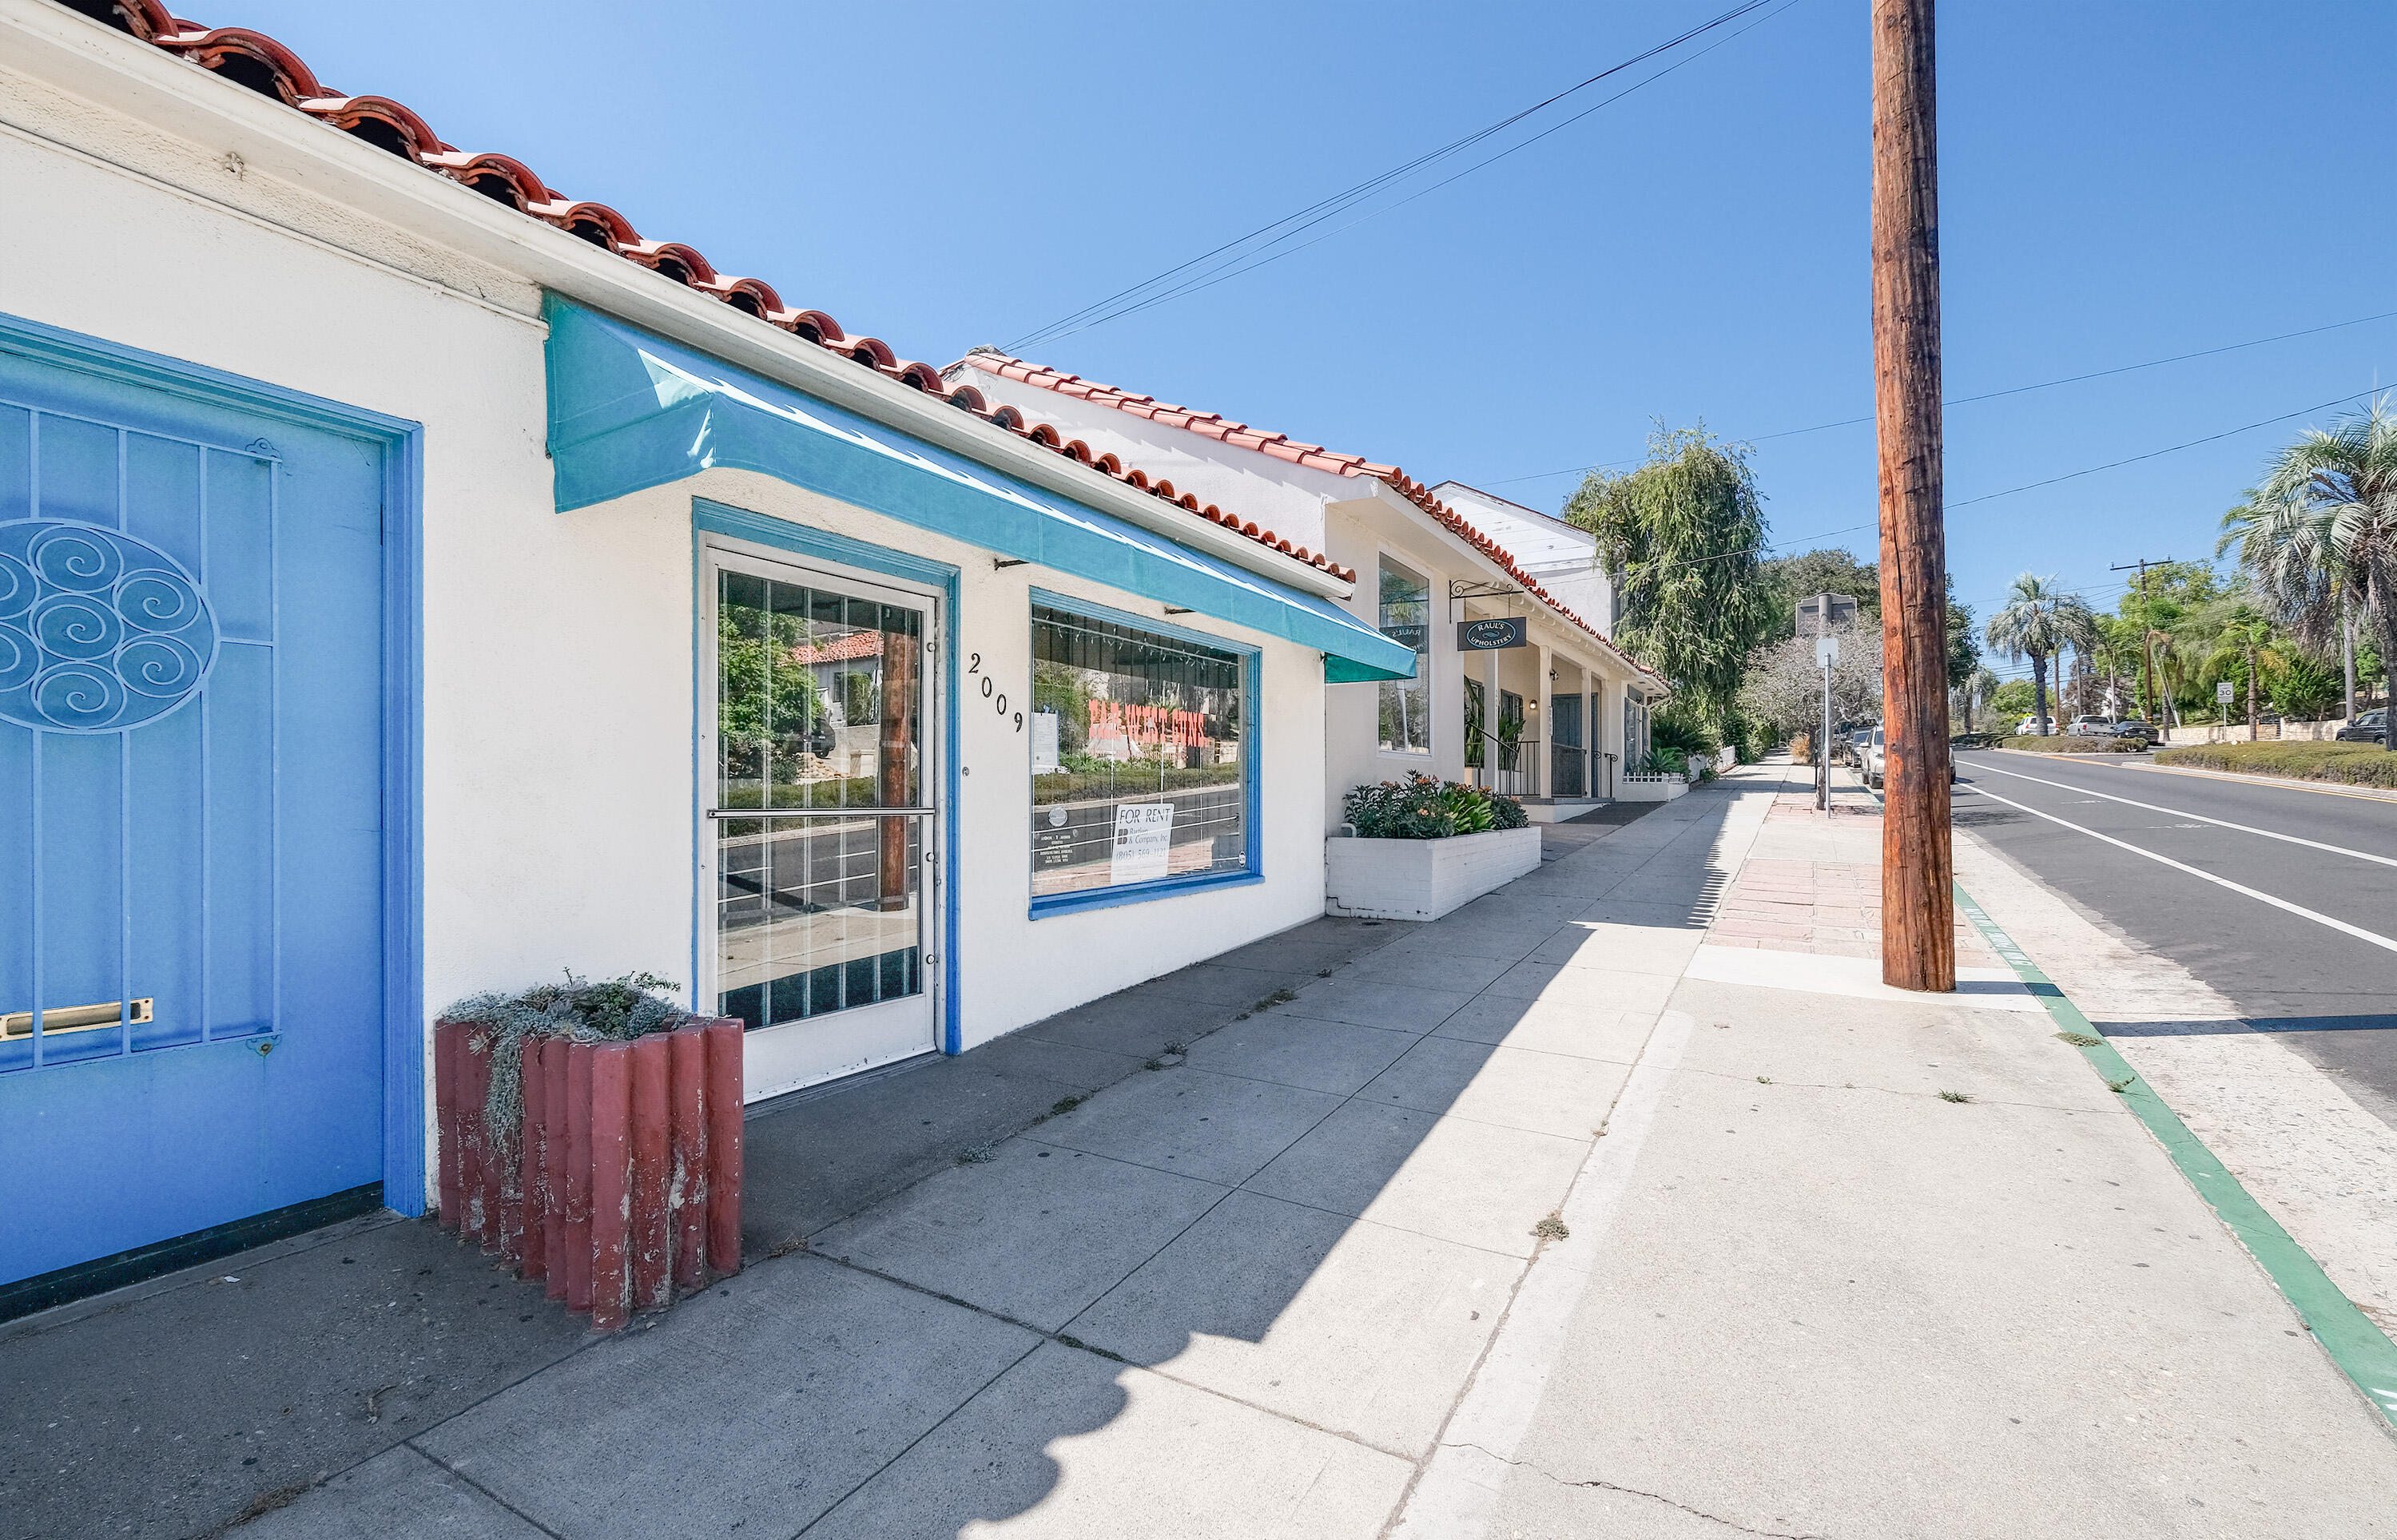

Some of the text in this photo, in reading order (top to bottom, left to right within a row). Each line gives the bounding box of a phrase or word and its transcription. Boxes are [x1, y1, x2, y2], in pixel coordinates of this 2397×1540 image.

[1477, 622, 1505, 632] RAUL'S
[1470, 633, 1512, 646] UPHOLSTERY
[968, 653, 1023, 732] 2009
[1088, 699, 1121, 741] FAR
[1124, 703, 1168, 745] WEST
[1119, 808, 1171, 824] FOR RENT
